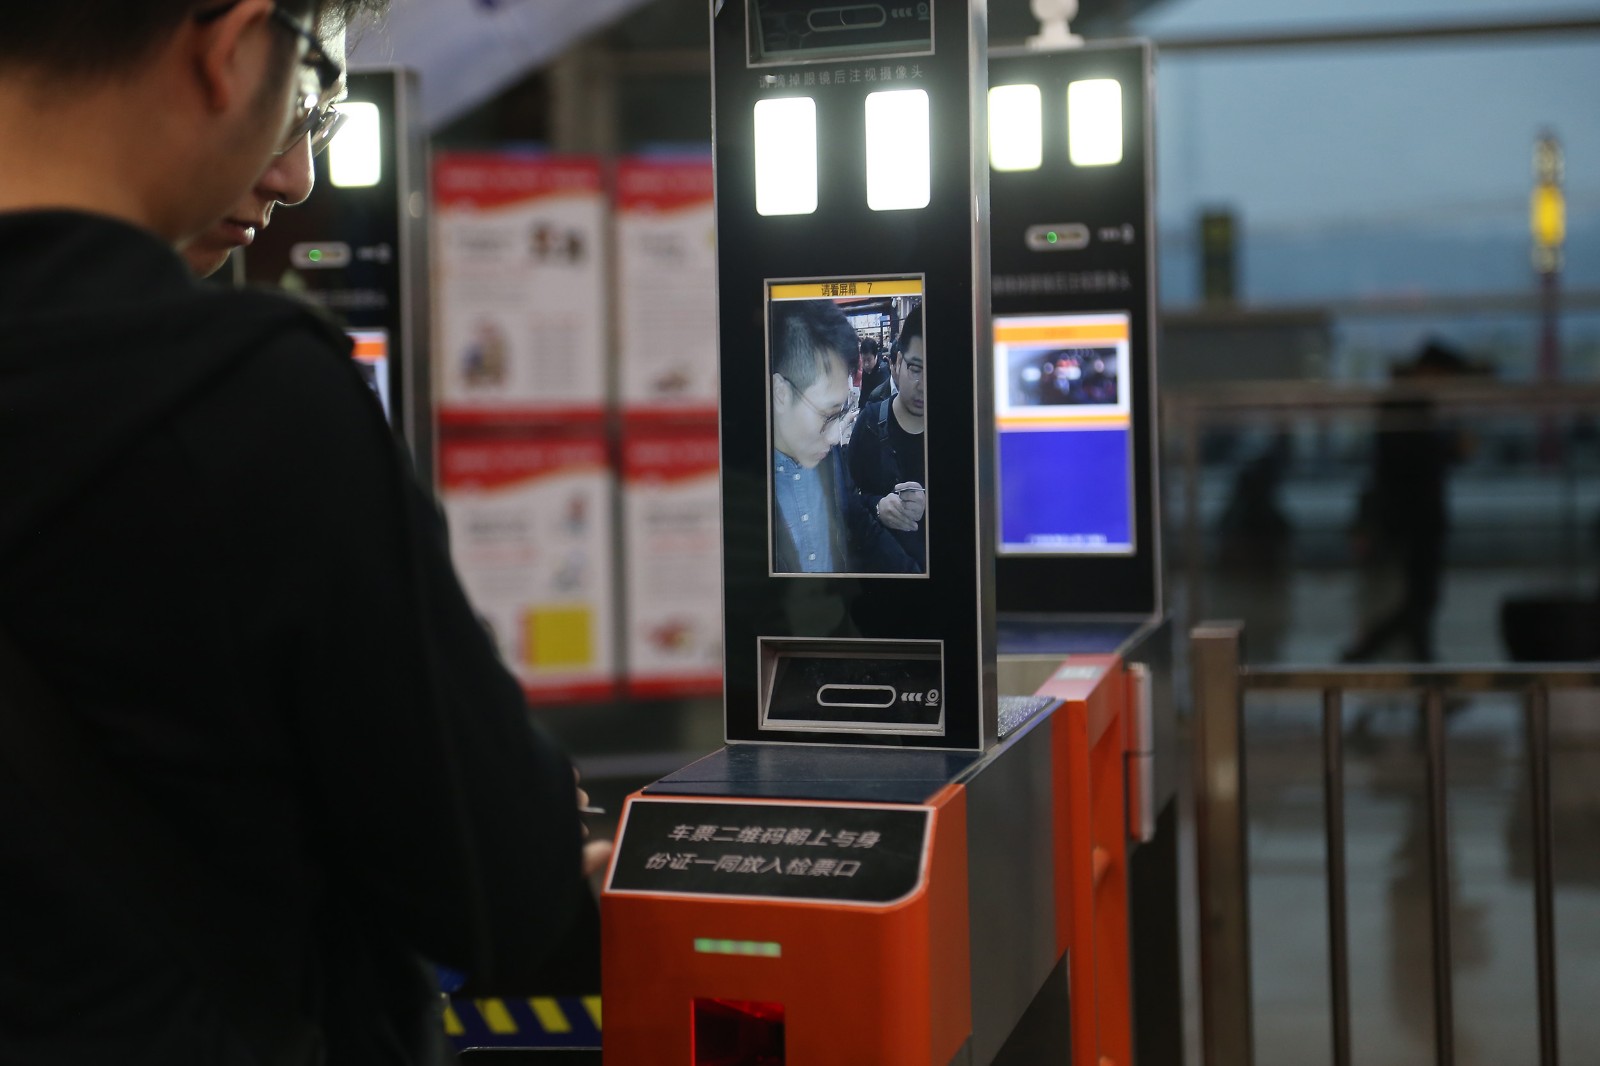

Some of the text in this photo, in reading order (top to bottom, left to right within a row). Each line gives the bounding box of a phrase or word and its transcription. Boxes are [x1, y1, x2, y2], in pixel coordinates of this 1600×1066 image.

[821, 283, 872, 296] 请看屏幕 7
[668, 825, 880, 848] 车票二维码朝上与身
[645, 853, 861, 877] 份证一同放入检票口
